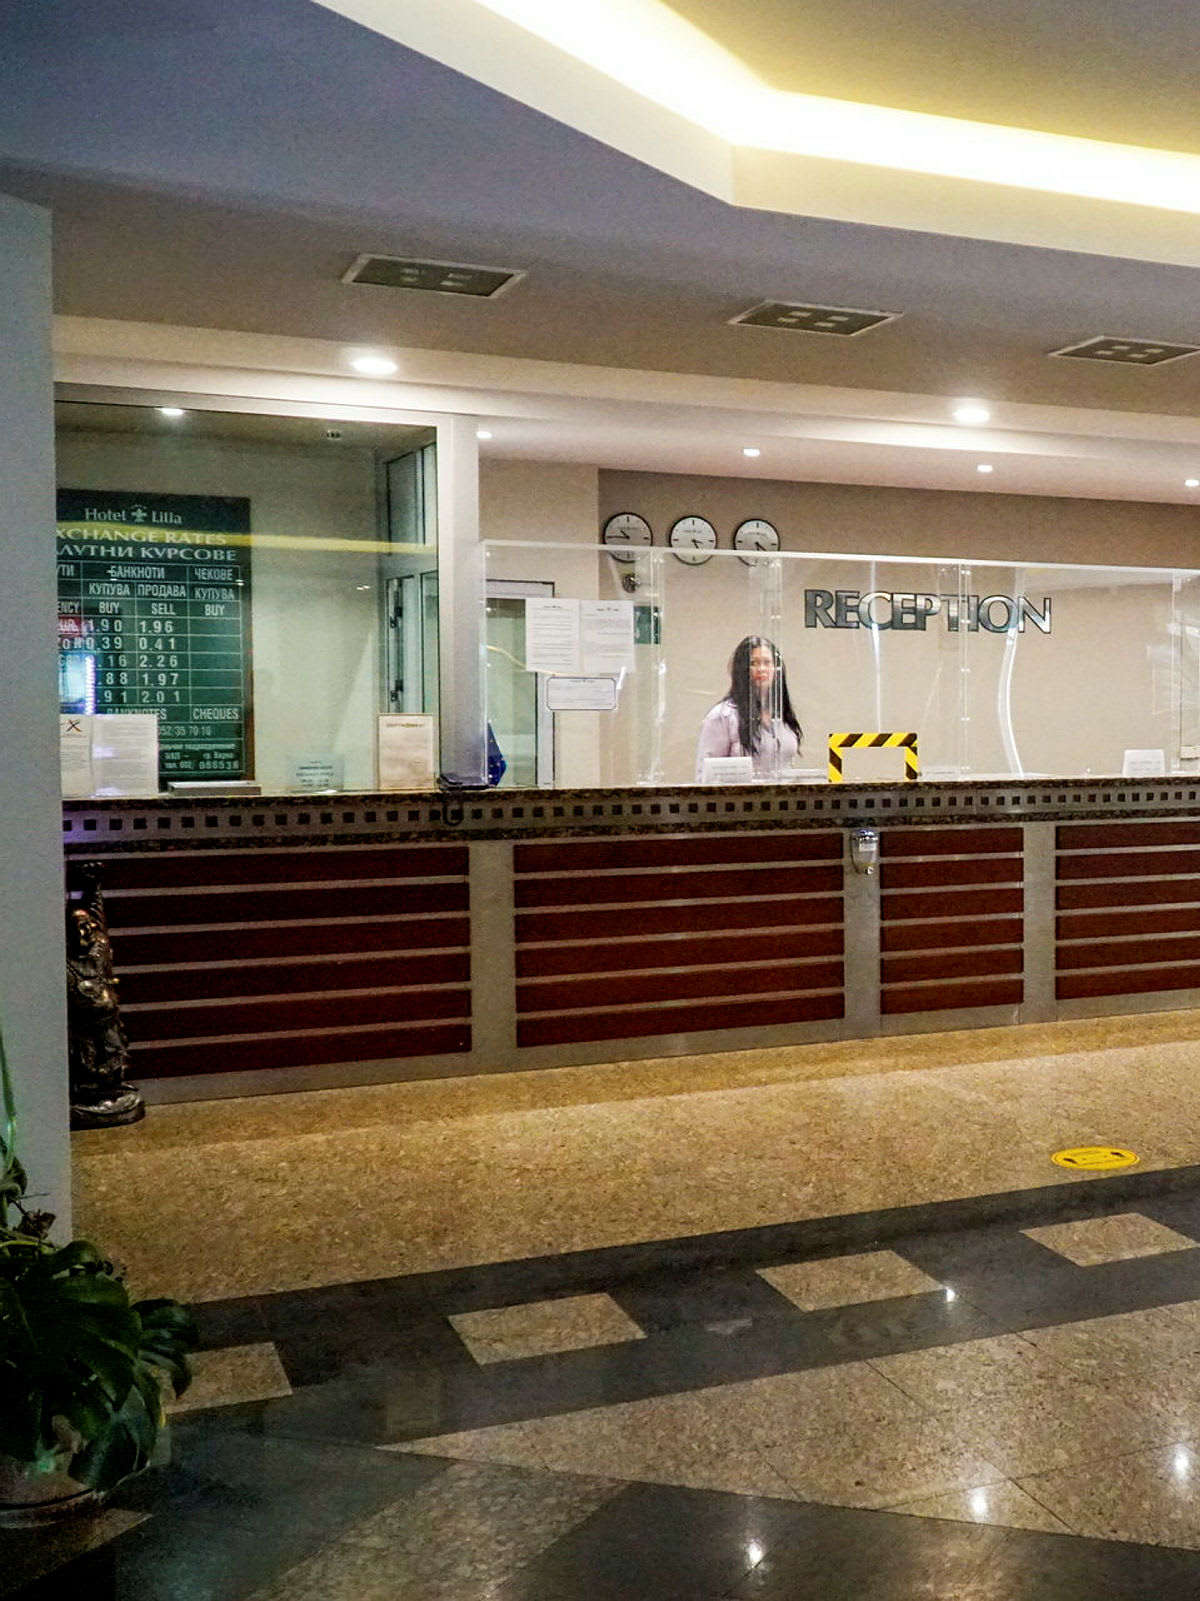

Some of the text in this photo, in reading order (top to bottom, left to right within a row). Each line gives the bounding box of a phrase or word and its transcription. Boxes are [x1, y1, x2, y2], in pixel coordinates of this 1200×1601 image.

[85, 508, 183, 525] Hotel Lilia
[56, 528, 227, 545] XCHANGE RATES
[56, 545, 237, 561] ЛУТНИ КУРСОВЕ
[110, 565, 165, 579] БАНКНОТИ
[194, 567, 233, 581] ЧЕКОВЕ
[89, 582, 235, 601] КУПУВА ПРОДАВА КУПУВА
[99, 601, 120, 614] BUY
[151, 603, 176, 616] SELL
[204, 604, 225, 616] BUY
[804, 589, 1052, 634] RECEPTION
[140, 620, 174, 634] 1.96
[139, 637, 176, 652] 0.41
[139, 654, 178, 668] 2.26
[142, 672, 179, 687] 1.97
[193, 708, 239, 720] CHEQUES
